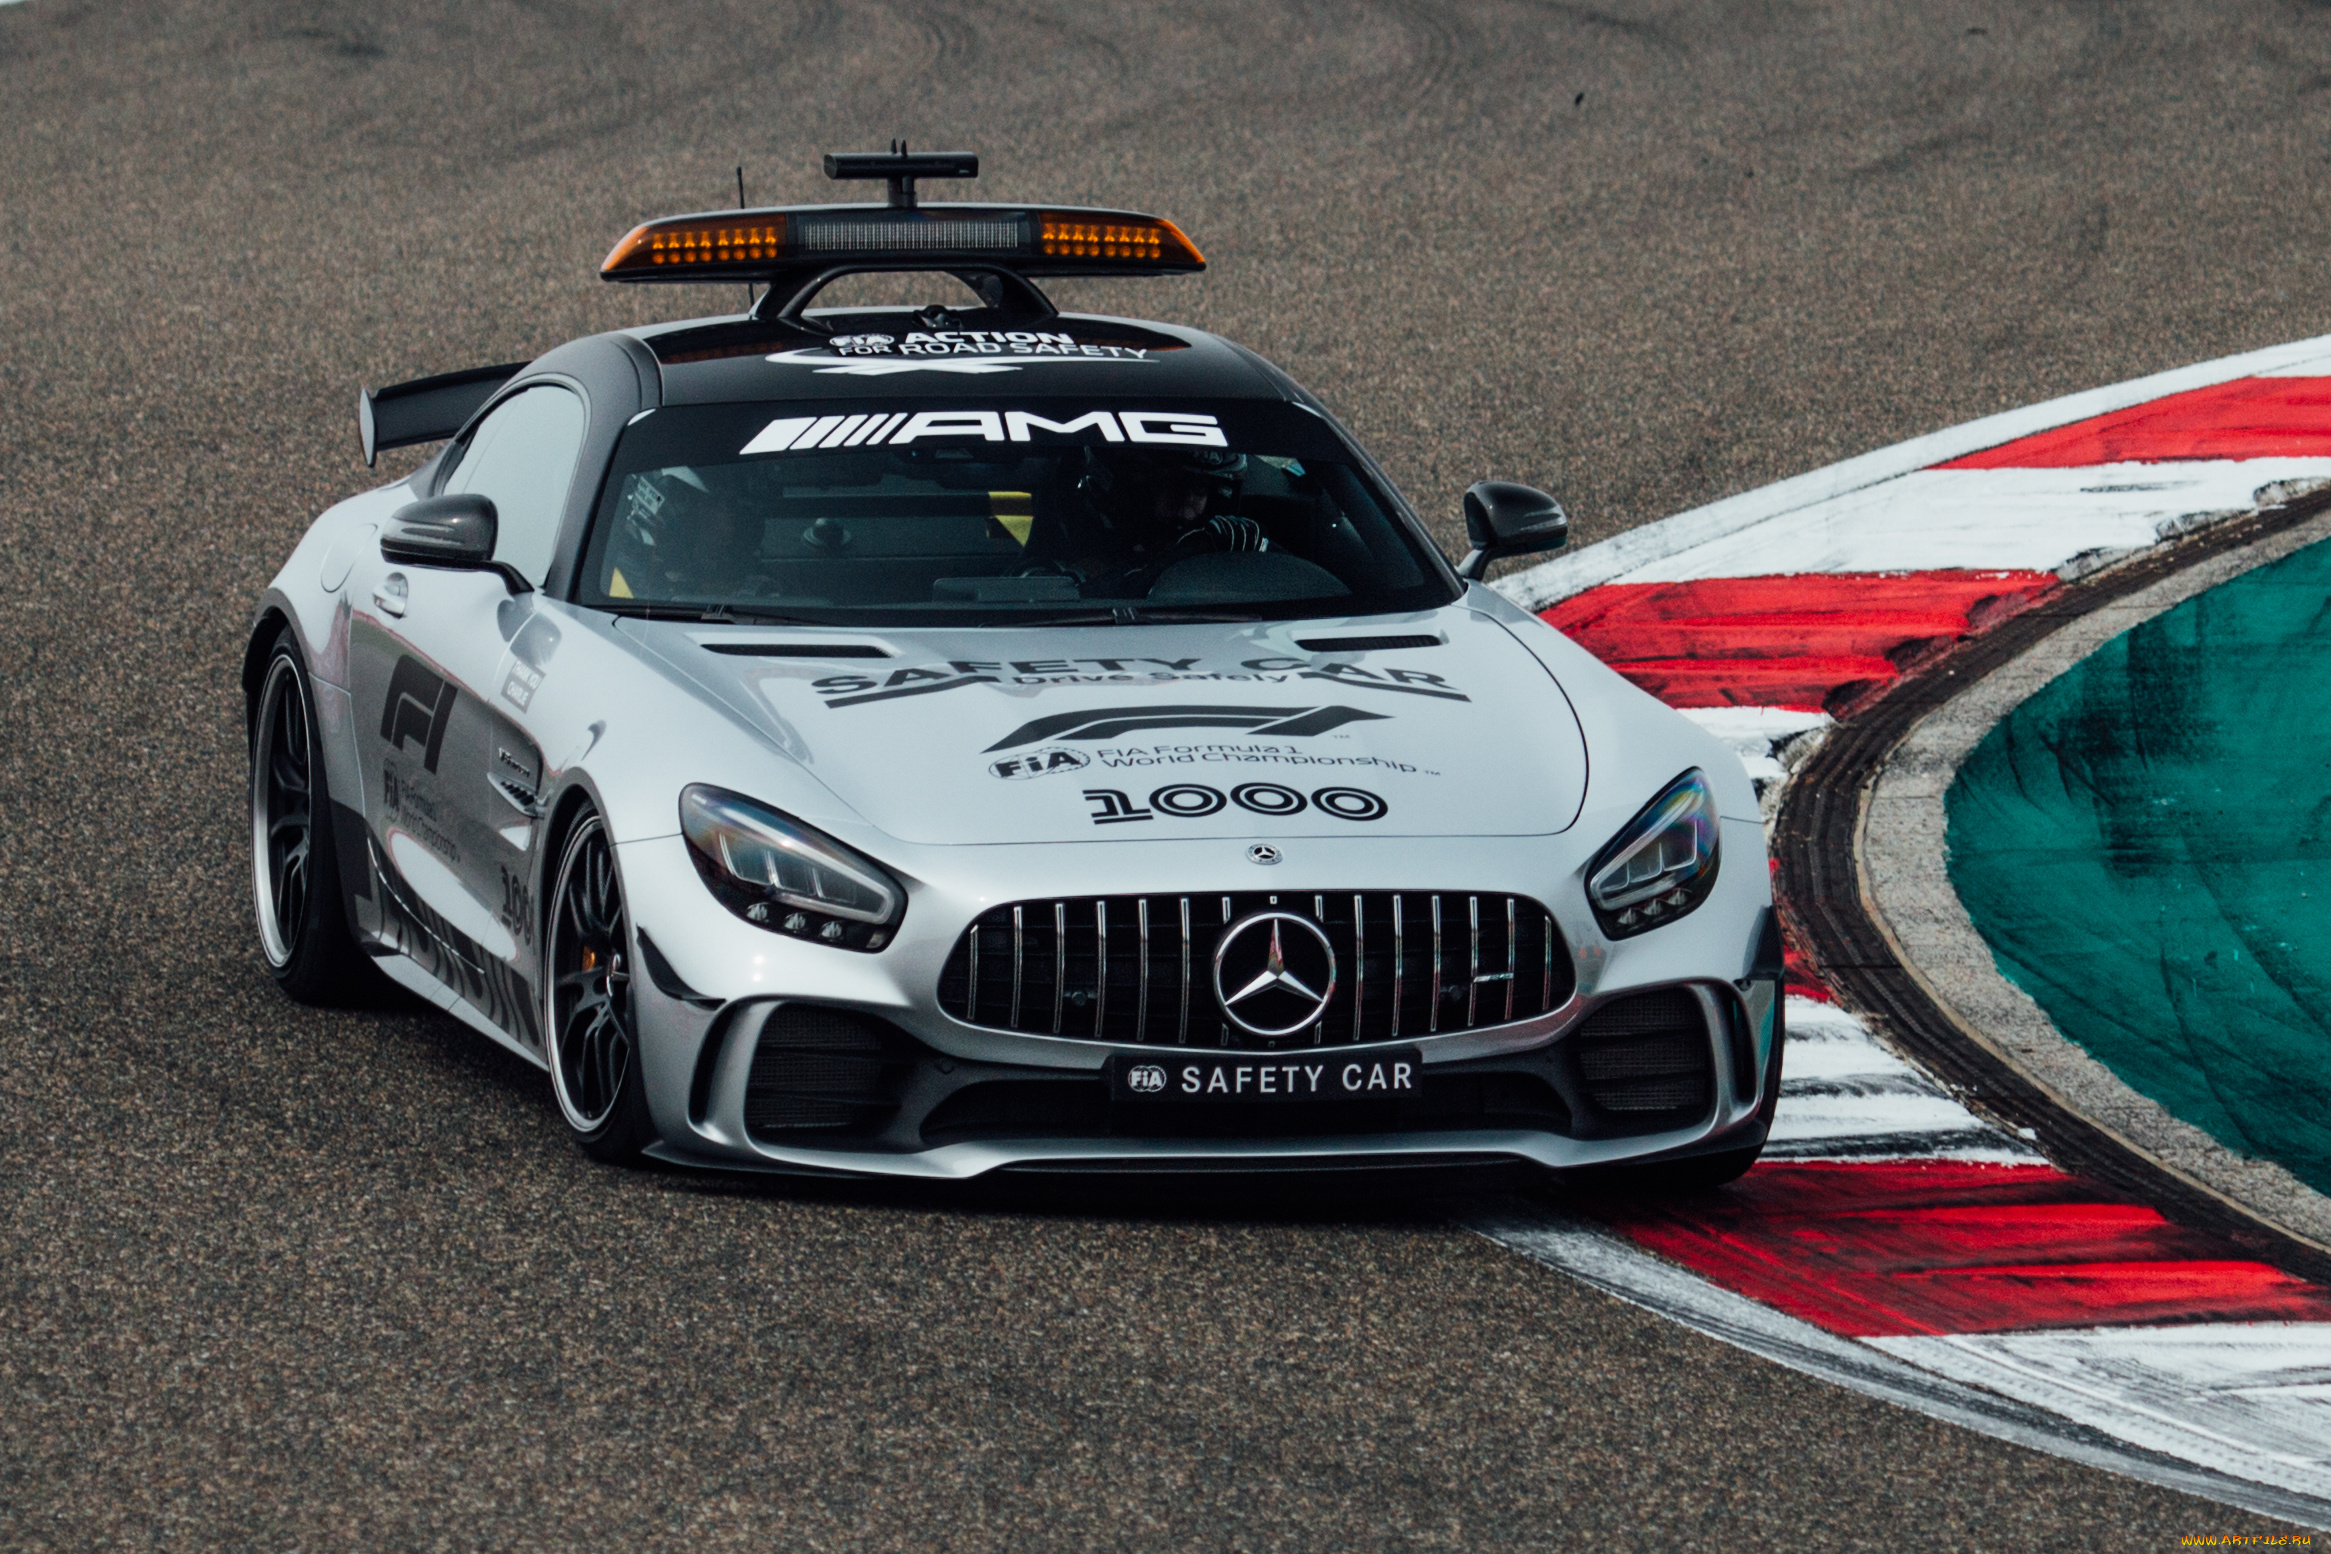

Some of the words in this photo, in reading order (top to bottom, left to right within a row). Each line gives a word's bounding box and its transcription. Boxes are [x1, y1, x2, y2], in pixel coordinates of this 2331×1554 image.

[905, 331, 1074, 344] ACTION
[839, 345, 892, 356] FOR
[899, 342, 1002, 355] ROAD
[1009, 342, 1148, 359] SAFETY
[888, 411, 1229, 447] AMG
[811, 658, 1201, 694] SAFETY
[1241, 657, 1460, 690] CAR
[1013, 673, 1134, 685] Drive
[1149, 672, 1289, 684] Safely
[1097, 747, 1148, 758] FIA
[1154, 745, 1281, 755] Formula
[1287, 745, 1303, 755] 1
[1102, 754, 1195, 768] World
[1202, 752, 1418, 774] Championship
[1082, 782, 1389, 825] 1000
[1182, 1064, 1324, 1094] SAFETY
[1342, 1063, 1412, 1091] CAR
